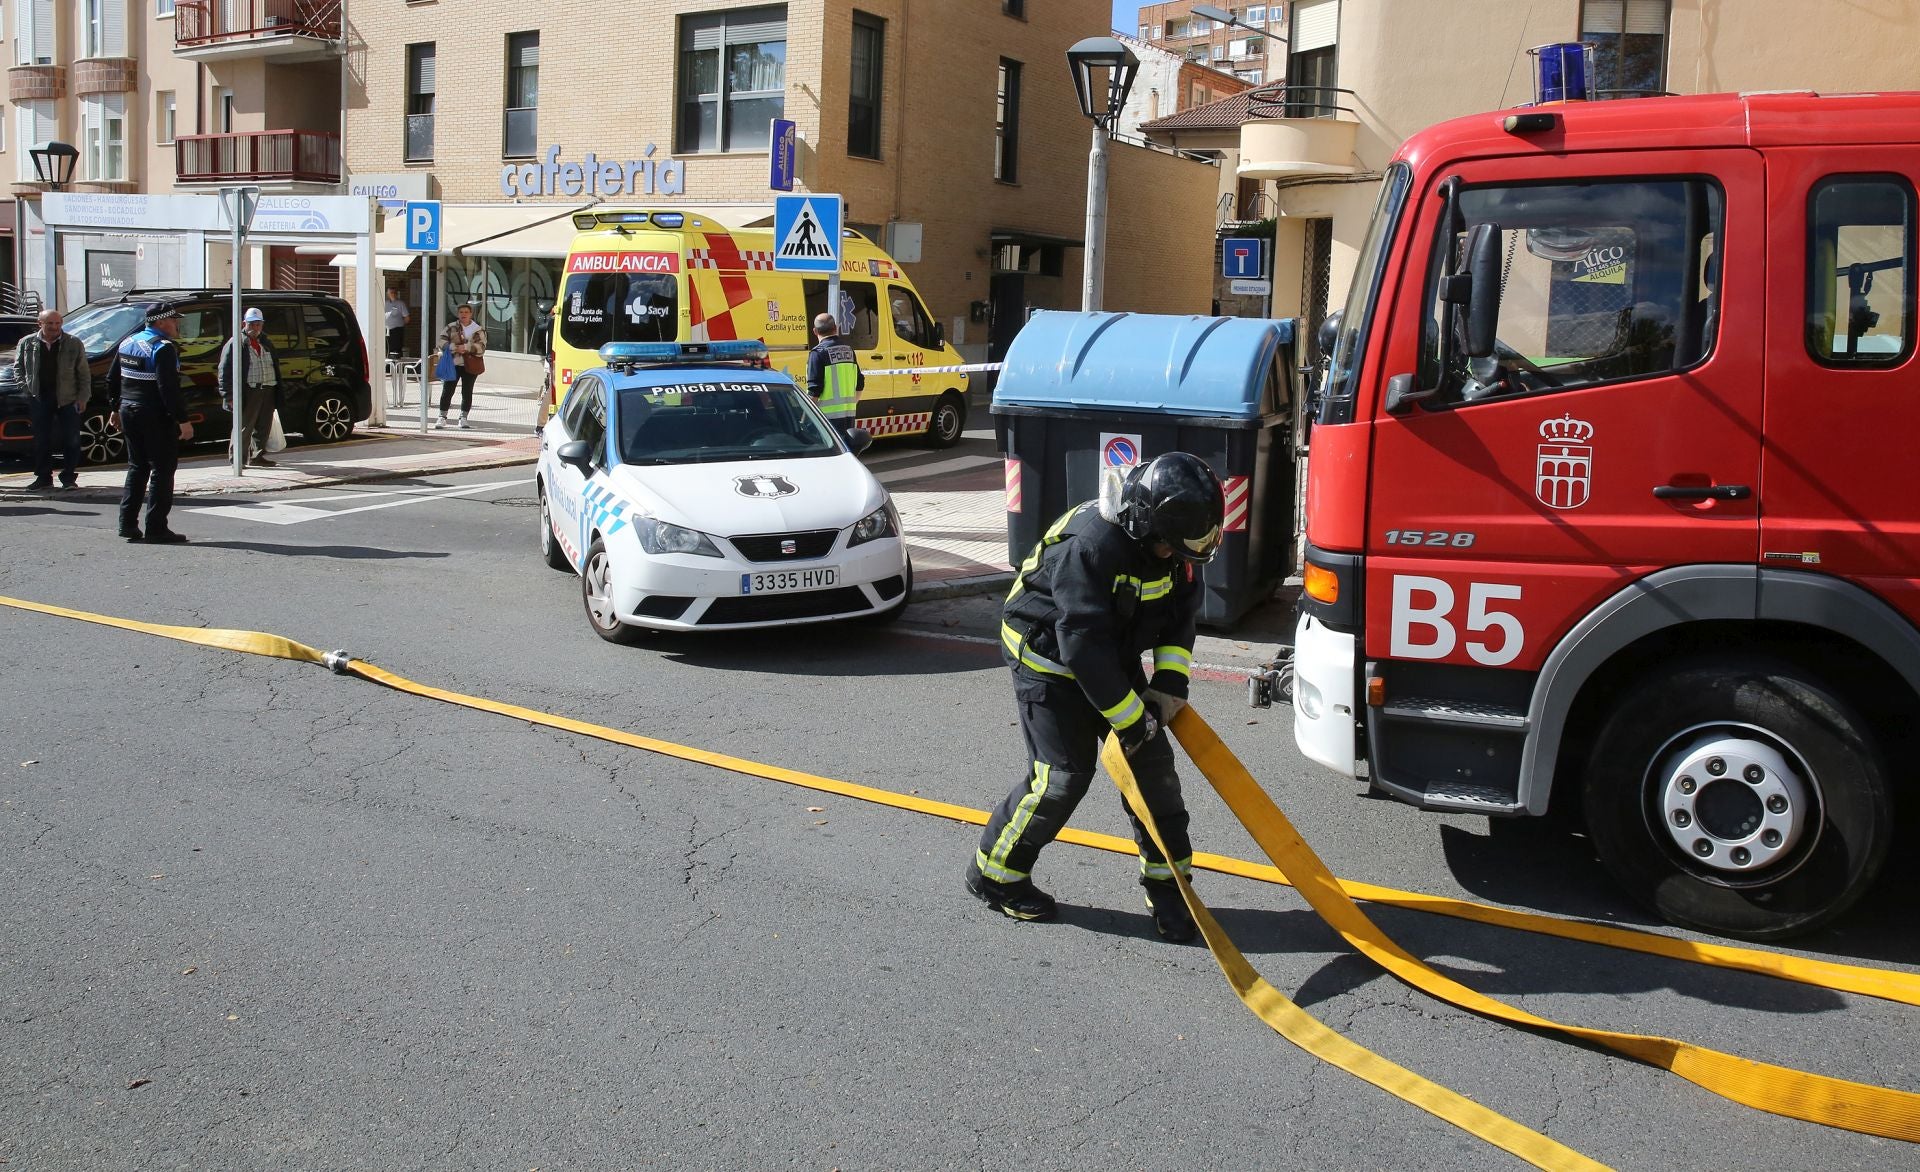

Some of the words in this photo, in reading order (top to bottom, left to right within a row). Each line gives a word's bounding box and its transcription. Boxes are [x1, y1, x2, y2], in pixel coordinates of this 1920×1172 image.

[500, 142, 685, 197] cafetería
[353, 185, 397, 199] GALLEGO
[257, 198, 311, 209] GALLEGO
[412, 208, 432, 244] P
[573, 255, 671, 271] AMBULANCIA
[1590, 265, 1624, 280] ALQUILA
[580, 308, 595, 316] Junta
[647, 306, 669, 317] Sacyl
[780, 314, 798, 322] Junta
[765, 323, 787, 331] Castilla
[911, 351, 924, 367] 112
[794, 375, 807, 384] Sacy
[651, 383, 717, 396] Policía
[720, 382, 769, 393] Local
[1385, 530, 1475, 547] 1528
[754, 572, 798, 591] 3335
[803, 569, 835, 588] HVD
[1390, 574, 1525, 666] B5
